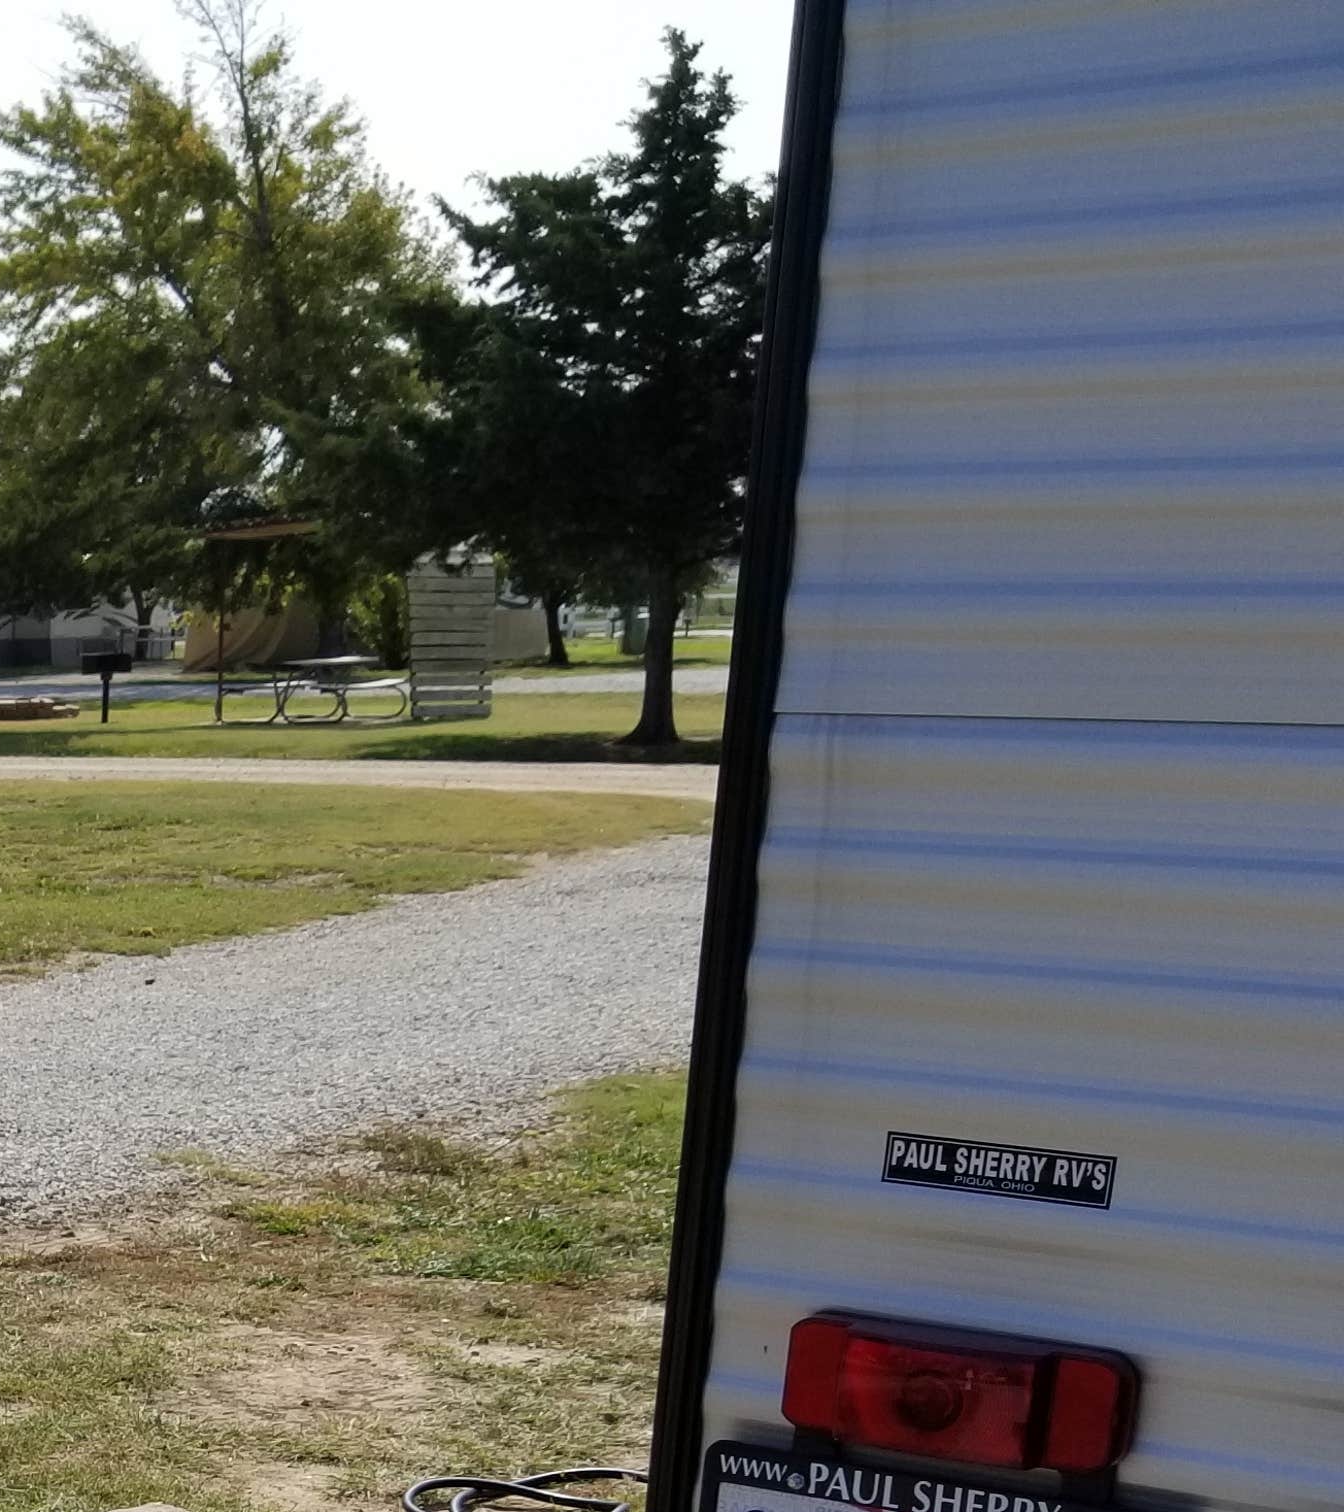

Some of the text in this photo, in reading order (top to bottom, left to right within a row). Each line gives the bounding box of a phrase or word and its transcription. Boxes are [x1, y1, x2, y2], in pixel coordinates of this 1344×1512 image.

[890, 1139, 1108, 1191] PAUL SHERRY RV'S
[953, 1174, 1036, 1193] PIQUA OHIO
[807, 1461, 900, 1509] PAUL
